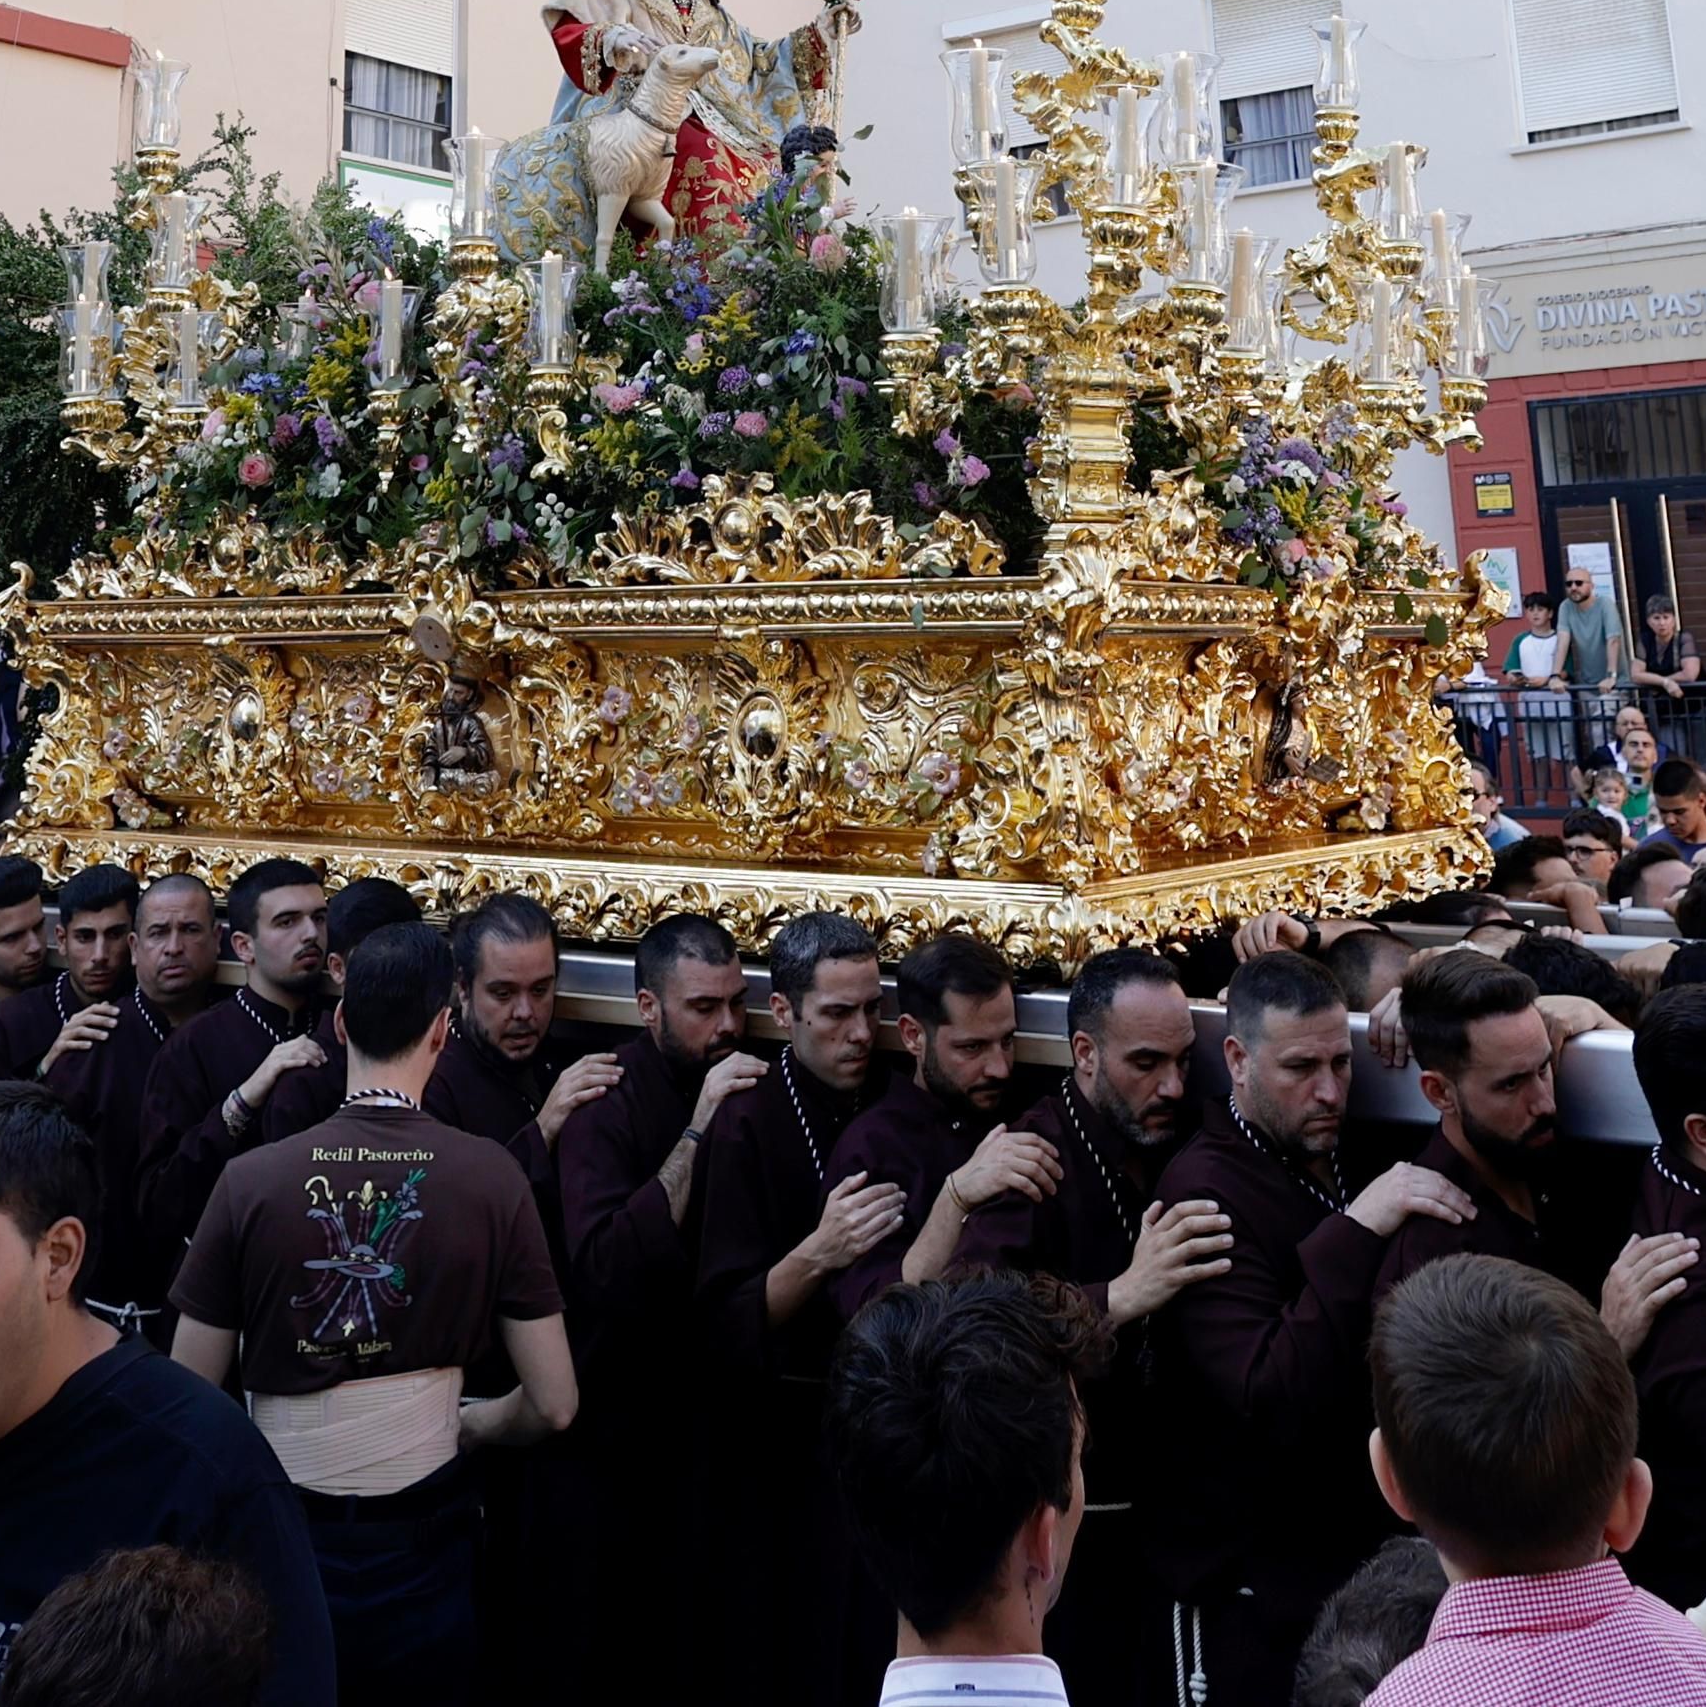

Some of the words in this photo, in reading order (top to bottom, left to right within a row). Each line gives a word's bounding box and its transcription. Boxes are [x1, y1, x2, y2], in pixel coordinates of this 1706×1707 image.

[1537, 293, 1586, 307] COLEGIO
[1588, 285, 1653, 302] DIOCESANO
[1536, 296, 1641, 333] DIVINA
[1541, 321, 1662, 350] FUNDACIÓN
[312, 1146, 353, 1162] Redil
[357, 1146, 434, 1162] Pastoreño
